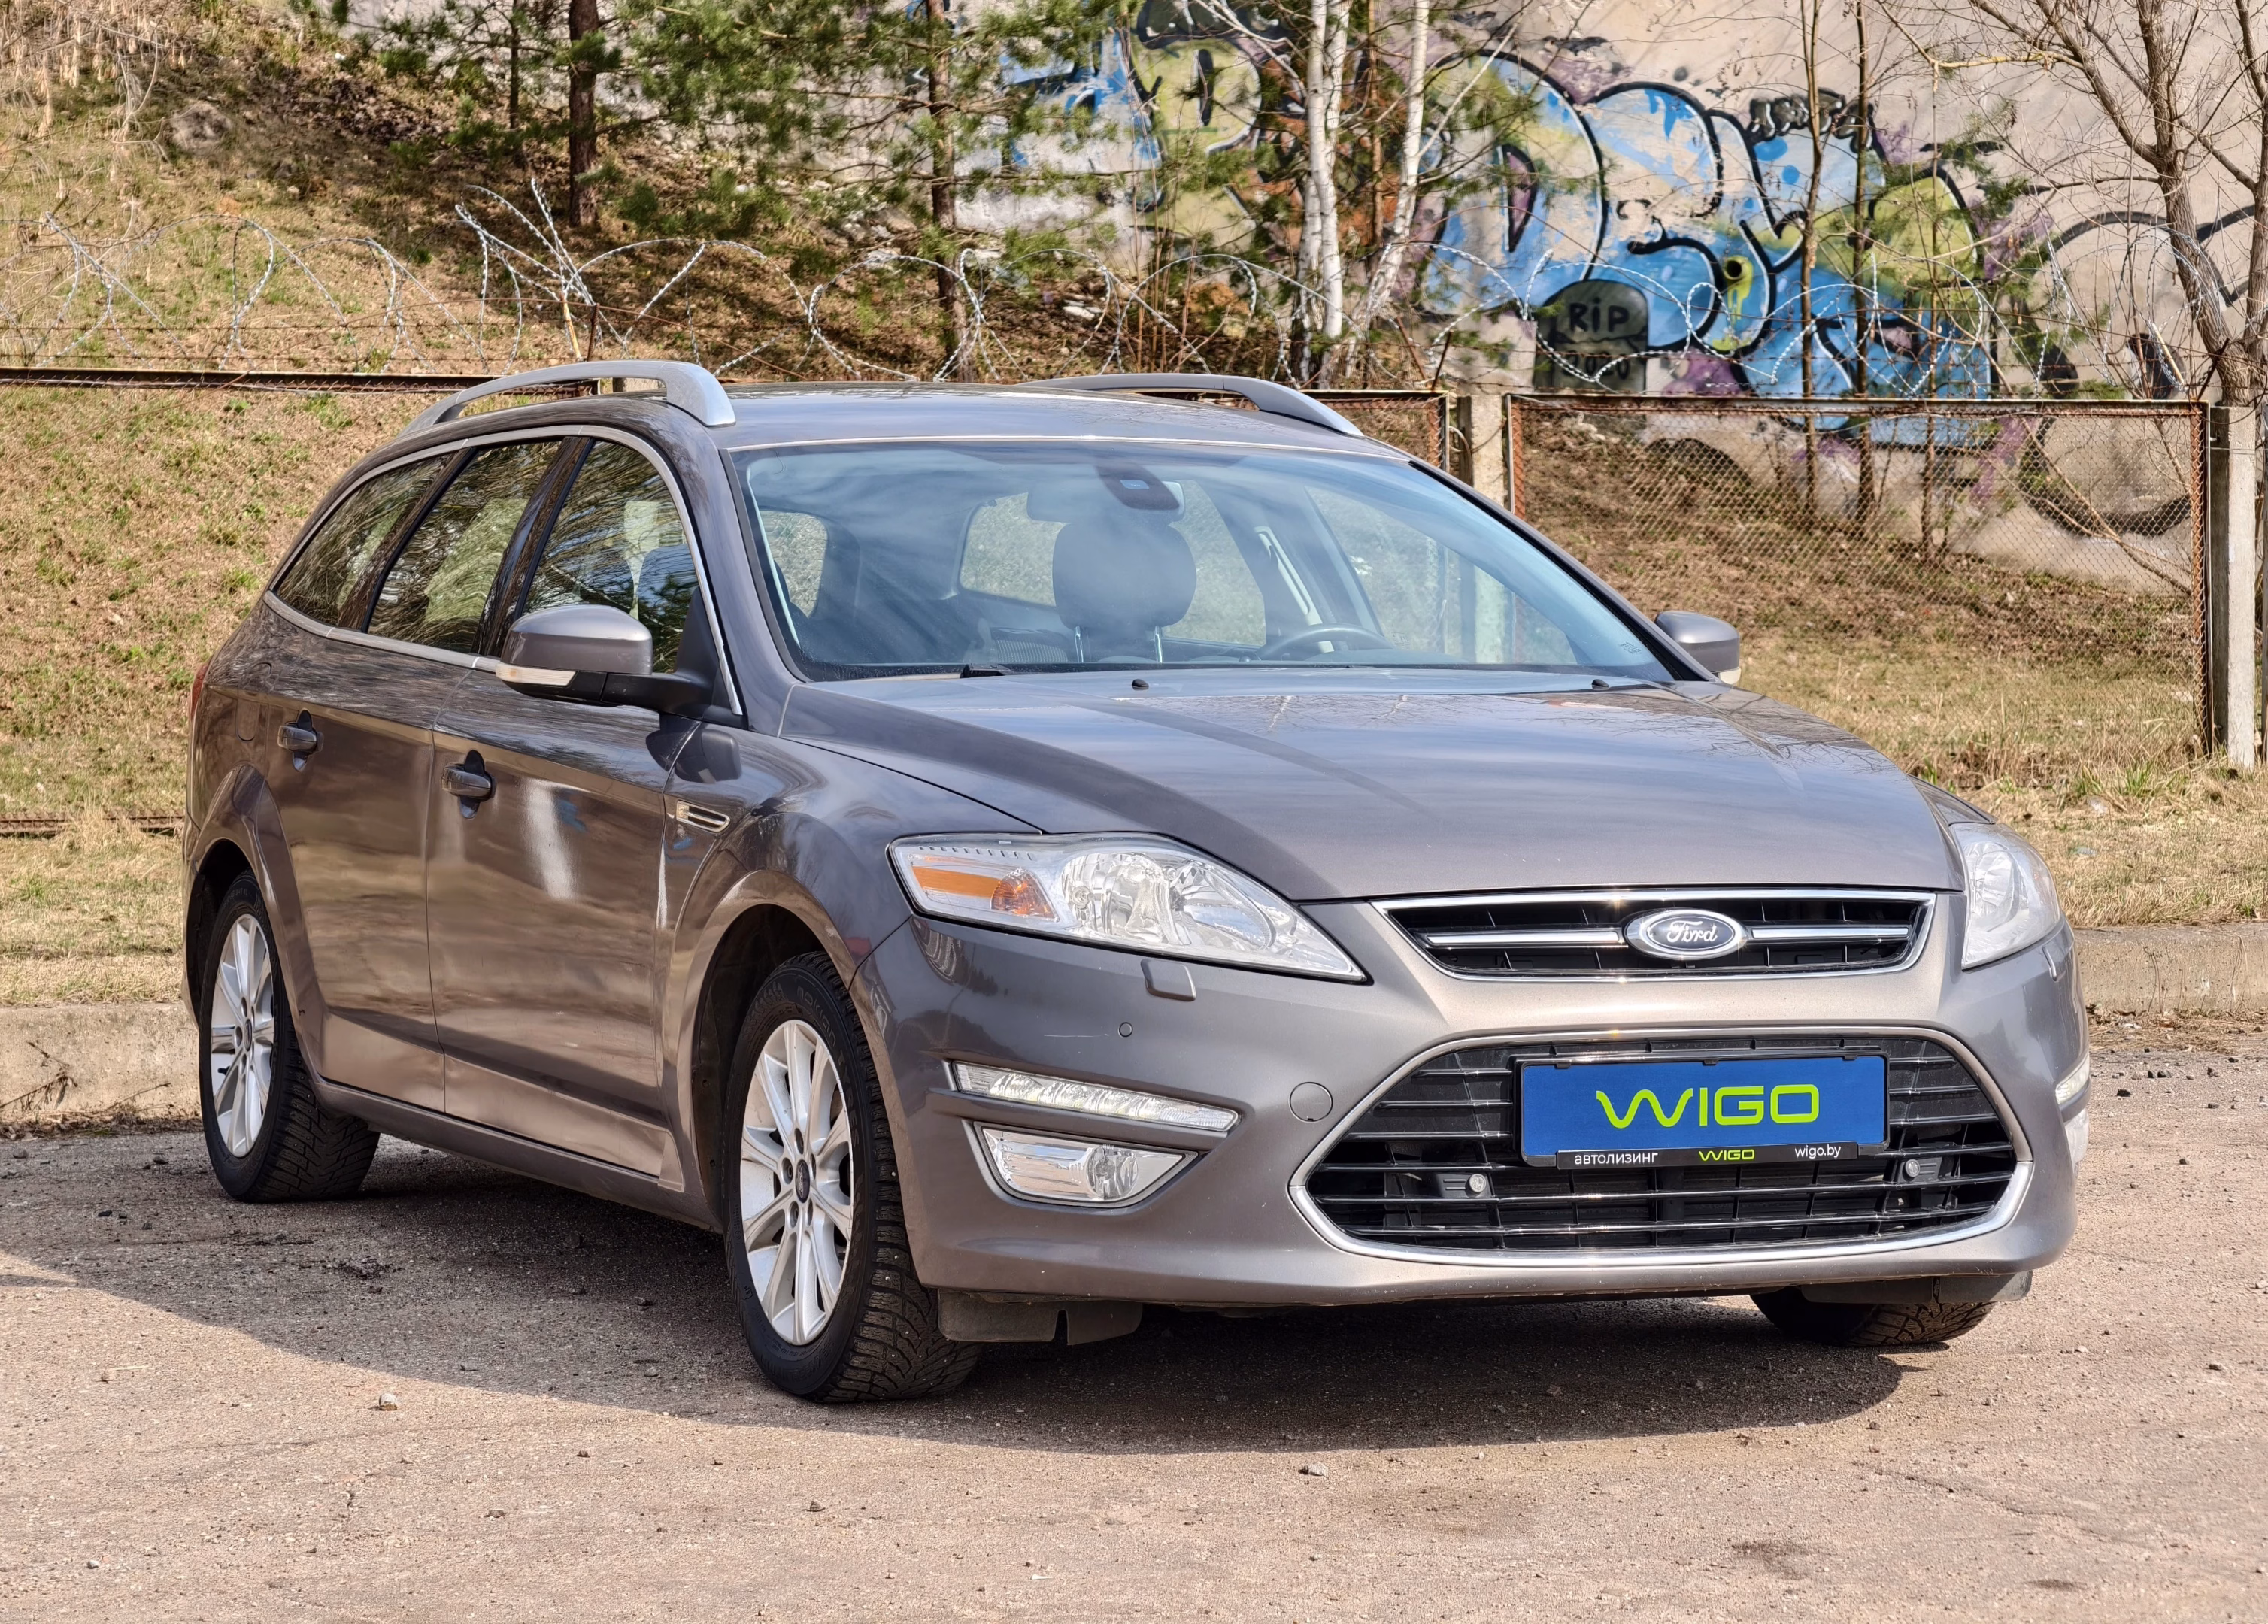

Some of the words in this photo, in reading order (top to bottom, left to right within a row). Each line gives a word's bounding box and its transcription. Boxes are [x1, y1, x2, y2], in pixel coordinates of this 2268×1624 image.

[1666, 920, 1718, 943] Ford
[1596, 1083, 1819, 1129] WIGO
[1574, 1150, 1658, 1165] автолизинг
[1698, 1148, 1755, 1162] WIGO
[1794, 1144, 1842, 1159] wigo.by
